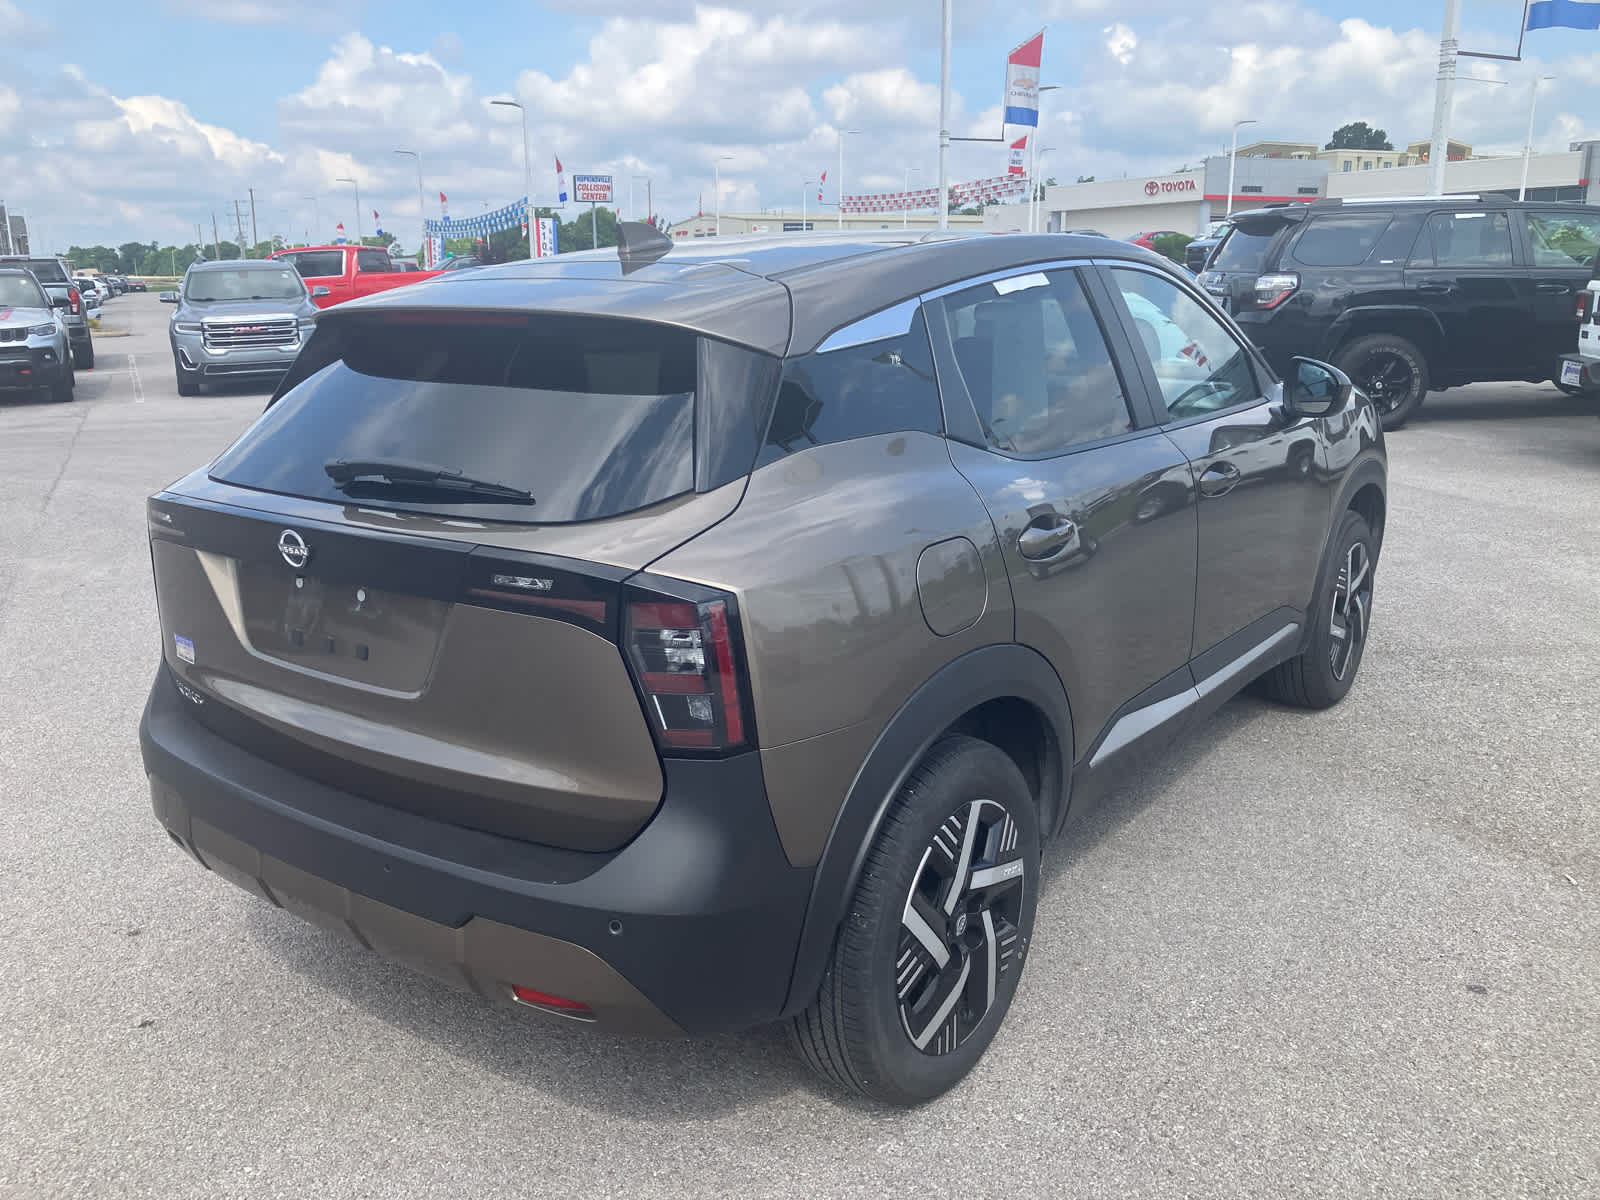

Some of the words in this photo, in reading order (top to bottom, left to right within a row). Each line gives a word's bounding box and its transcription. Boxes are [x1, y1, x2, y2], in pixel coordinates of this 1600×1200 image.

[577, 183, 611, 192] COLLISION
[1160, 180, 1195, 192] TOYOTA
[581, 192, 608, 201] CENTER
[278, 544, 308, 557] NISSAN
